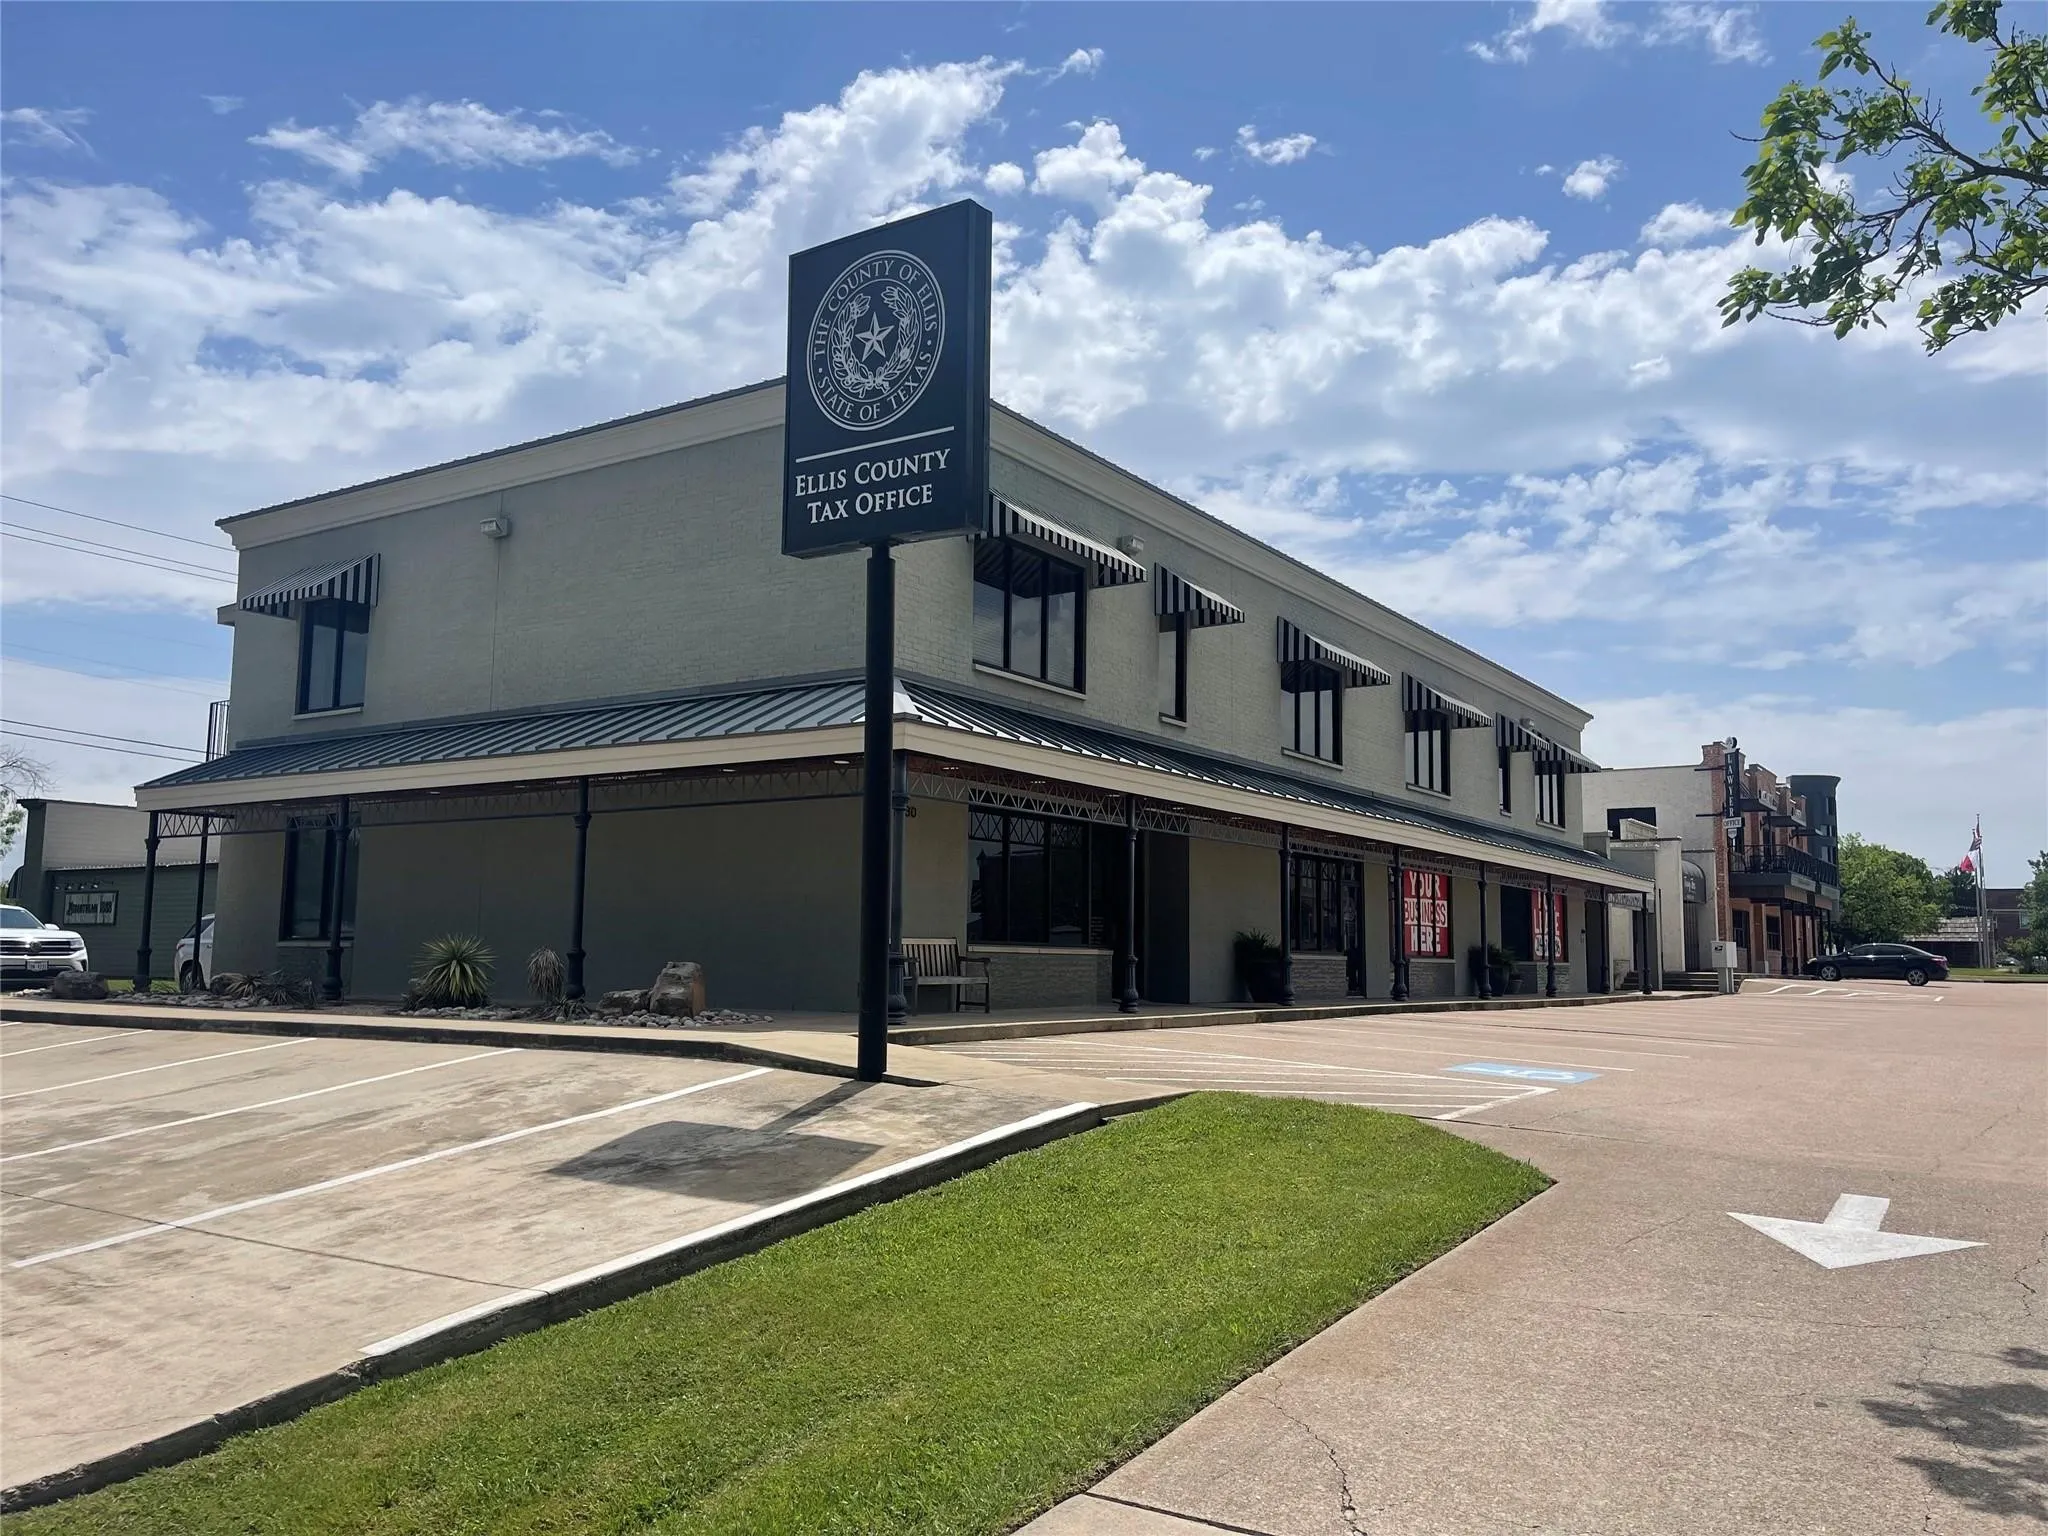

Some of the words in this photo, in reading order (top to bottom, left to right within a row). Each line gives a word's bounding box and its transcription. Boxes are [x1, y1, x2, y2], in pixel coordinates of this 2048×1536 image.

[814, 318, 831, 360] THE
[828, 260, 894, 311] COUNTY
[899, 264, 920, 284] OF
[917, 283, 937, 331] ELLIS
[818, 376, 854, 418] STATE
[860, 403, 880, 420] OF
[887, 352, 931, 409] TEXAS
[795, 469, 847, 496] ELLIS
[854, 448, 951, 485] COUNTY
[807, 499, 849, 524] TAX
[855, 484, 933, 515] OFFICE
[1726, 753, 1735, 818] LAWYER
[1409, 871, 1441, 898] YOUR
[1410, 926, 1441, 952] HERE
